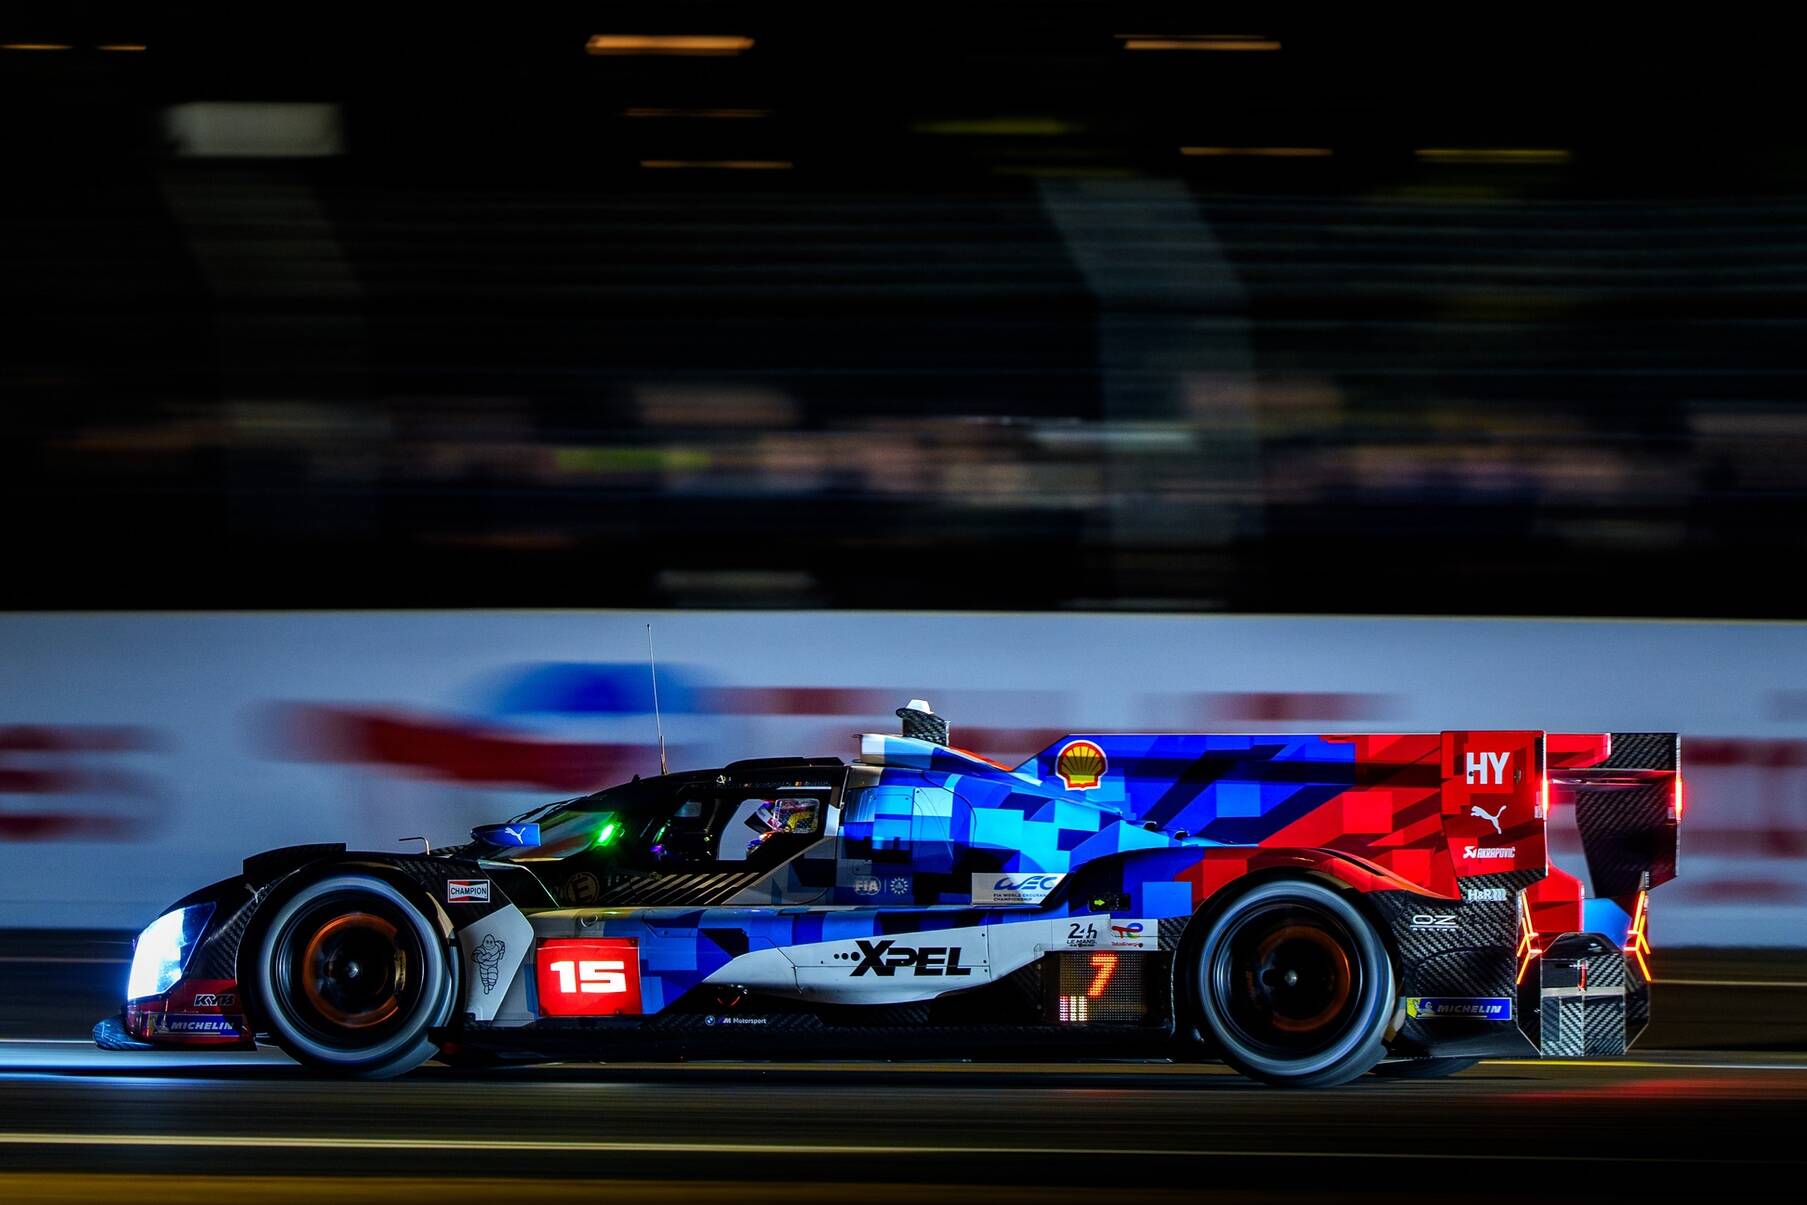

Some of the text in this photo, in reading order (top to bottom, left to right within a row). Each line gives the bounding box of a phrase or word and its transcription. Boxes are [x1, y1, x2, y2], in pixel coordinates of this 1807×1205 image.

[1466, 752, 1510, 785] HY
[855, 880, 879, 892] FIA
[993, 875, 1058, 891] WEC
[450, 887, 488, 895] CHAMPION
[1467, 888, 1492, 901] H&R
[1067, 922, 1098, 939] 24h
[849, 940, 972, 977] XPEL
[550, 960, 627, 993] 15
[1087, 954, 1119, 997] 7
[1436, 1005, 1503, 1014] MICHELIN
[170, 1021, 234, 1030] MICHELIN
[732, 1017, 767, 1025] Motorsport
